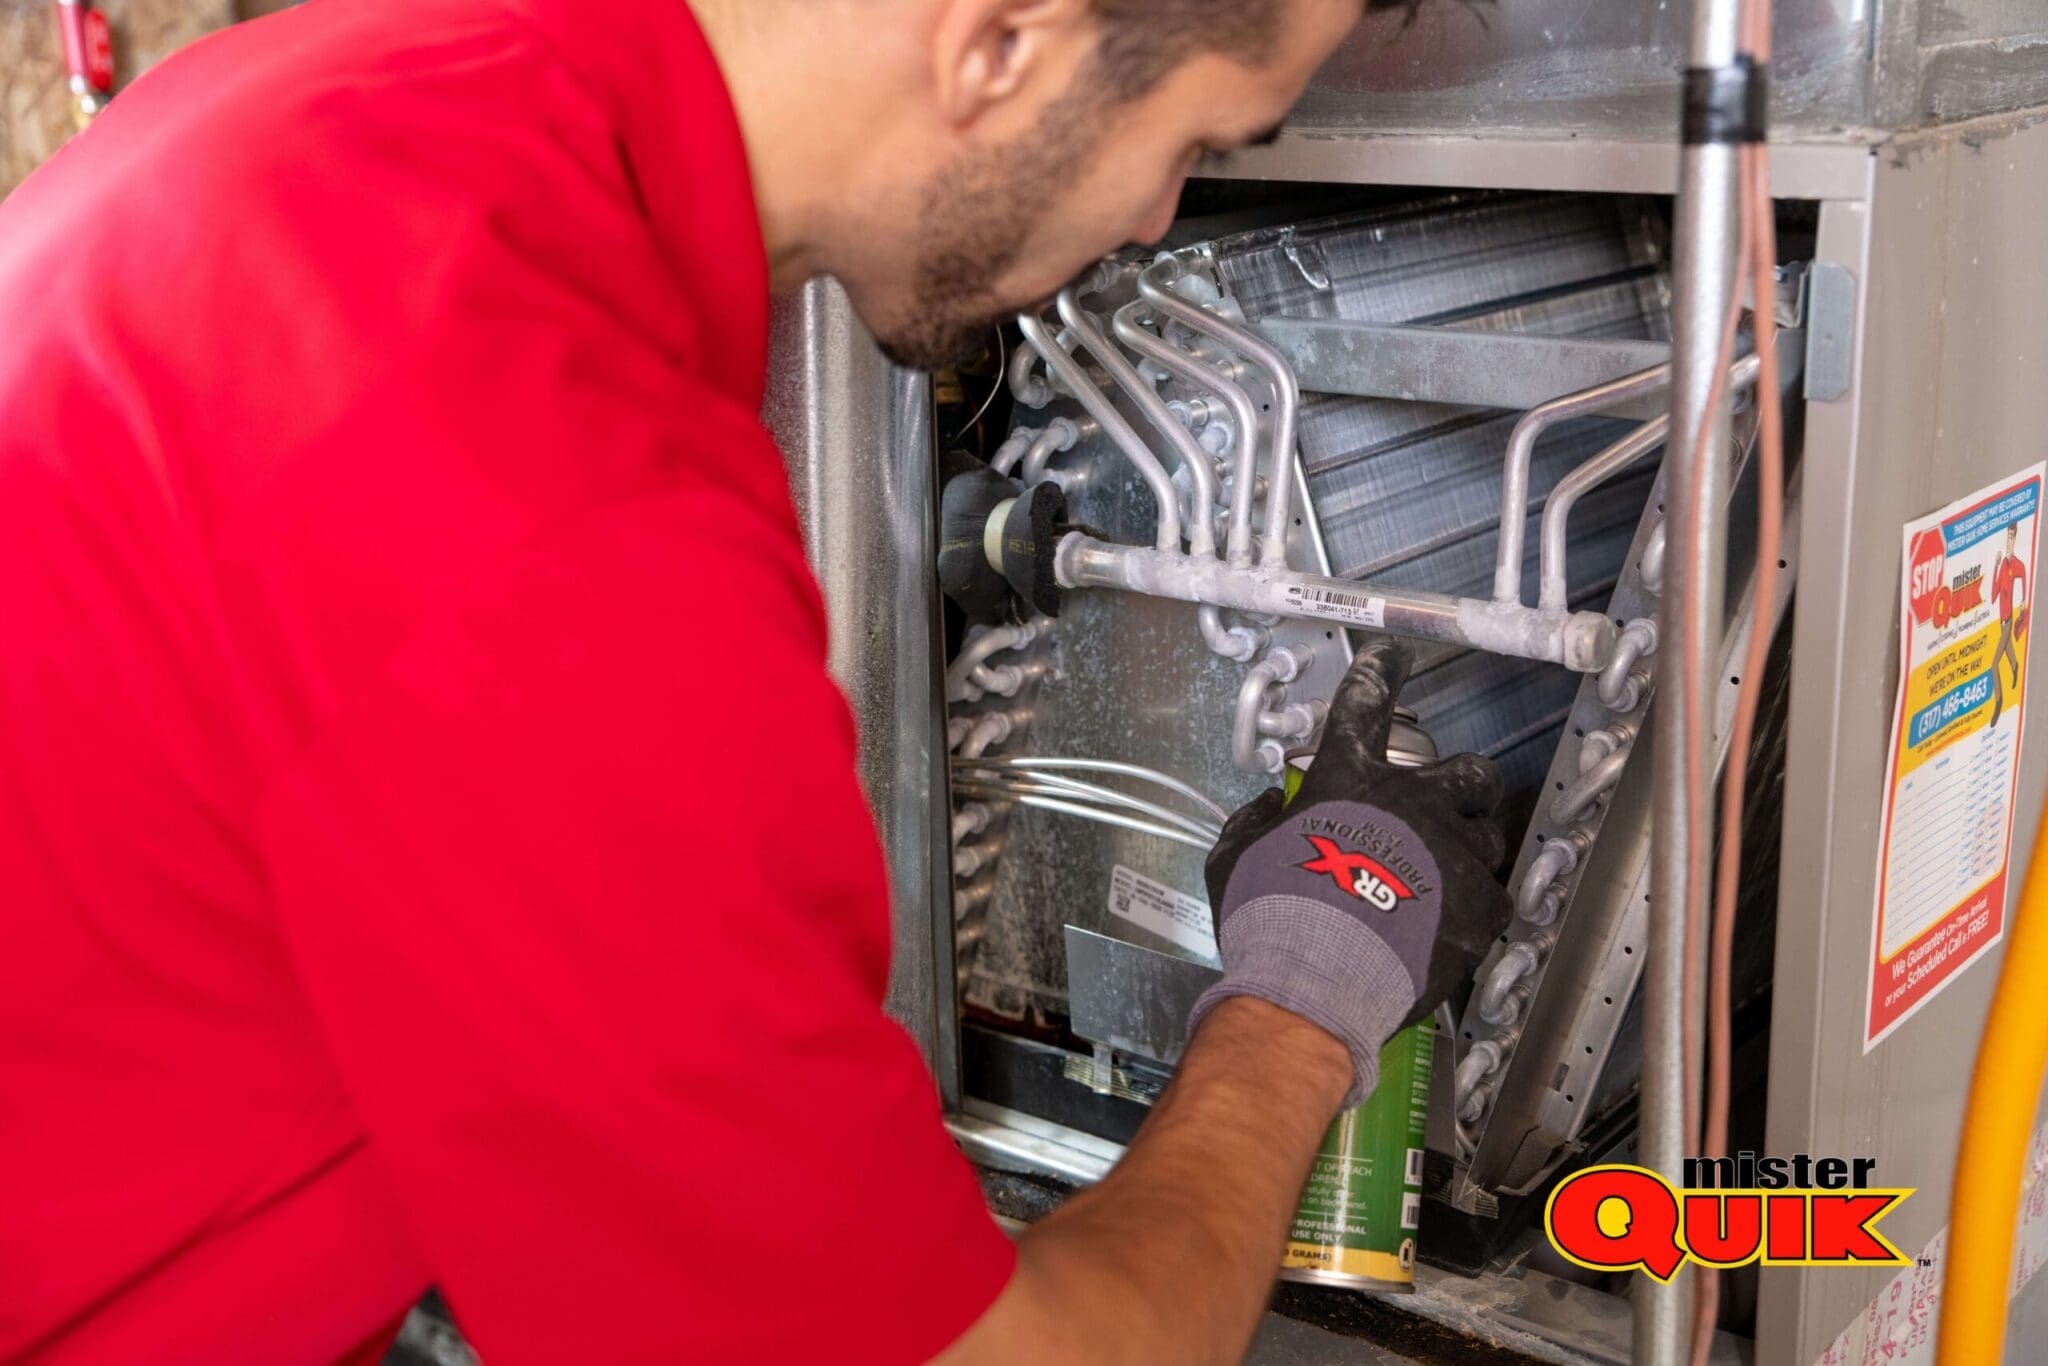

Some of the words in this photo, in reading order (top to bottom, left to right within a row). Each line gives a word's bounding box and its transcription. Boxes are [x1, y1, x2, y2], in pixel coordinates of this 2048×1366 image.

[1912, 554, 1943, 600] STOP
[1952, 564, 1981, 590] mister
[1932, 574, 1984, 630] QUIK
[1926, 662, 1941, 680] OPEN
[1940, 651, 1957, 672] UNTIL
[1946, 671, 1956, 686] ON
[1957, 663, 1970, 679] THE
[1970, 656, 1982, 673] WAY
[1918, 703, 1941, 739] (317)
[1942, 675, 1989, 719] 466-8463
[1302, 818, 1433, 895] PROFESSIONAL
[1884, 994, 1893, 1008] or
[1892, 982, 1906, 1004] your
[1907, 942, 1948, 990] Scheduled
[1947, 930, 1962, 956] Call
[1892, 958, 1906, 981] We
[1907, 928, 1946, 968] Guarantee
[1292, 1230, 1311, 1239] USE
[1314, 1231, 1342, 1242] ONLY
[1296, 1218, 1367, 1235] ROFESSONAL
